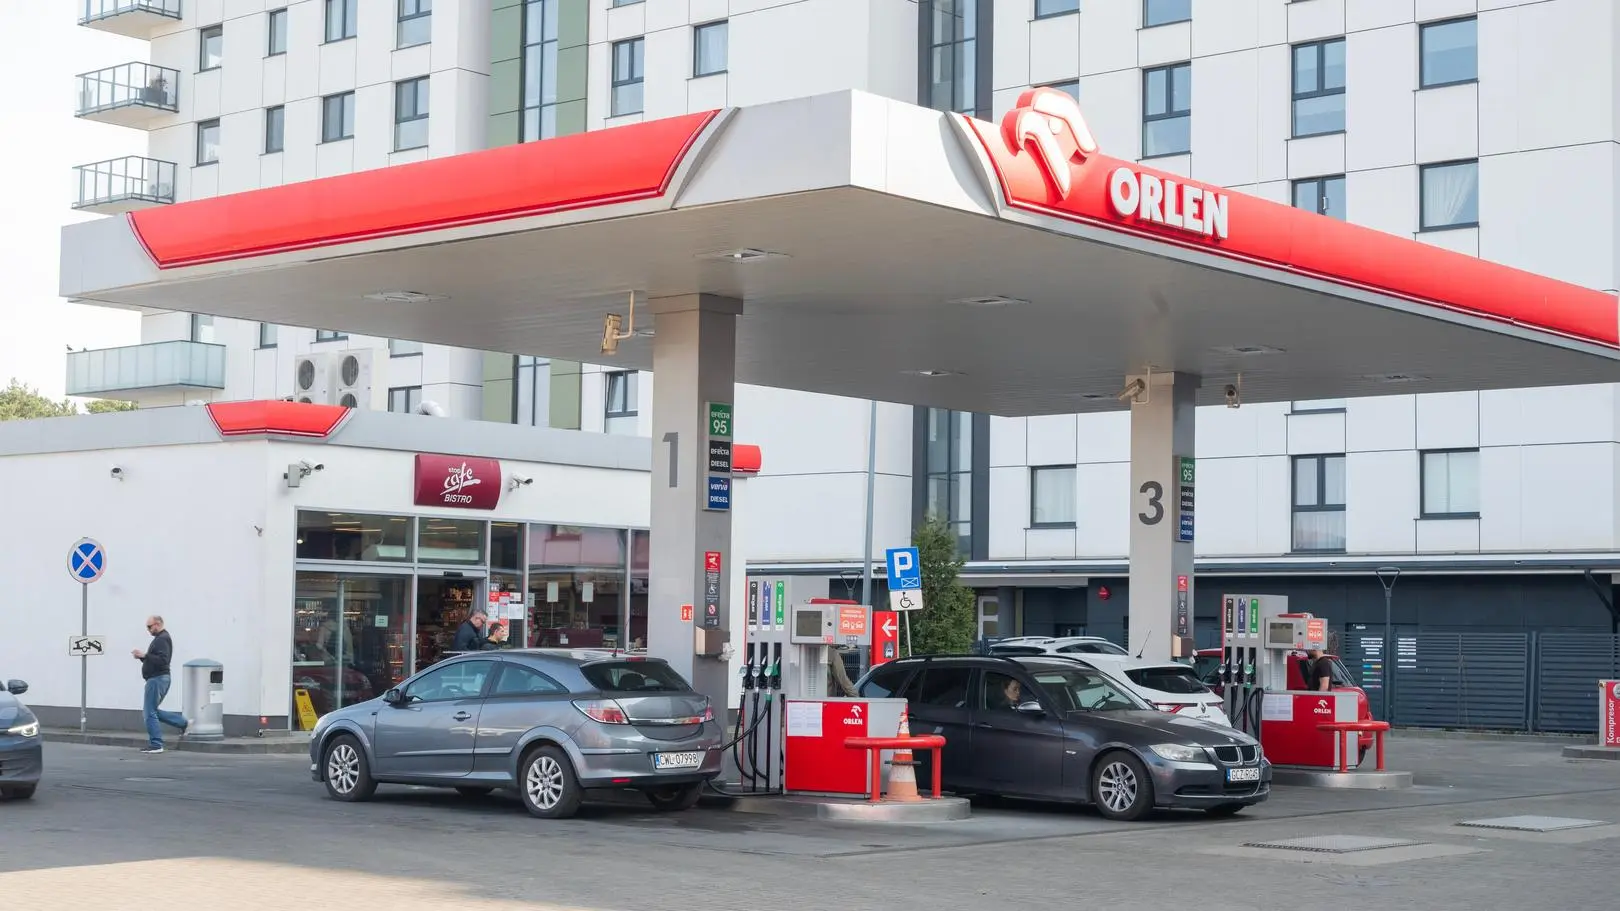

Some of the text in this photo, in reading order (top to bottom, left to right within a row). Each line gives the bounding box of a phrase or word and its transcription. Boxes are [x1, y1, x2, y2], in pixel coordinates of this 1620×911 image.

[1109, 166, 1228, 240] ORLEN
[713, 419, 727, 434] 95
[662, 431, 679, 488] 1
[710, 460, 729, 468] DIESEL
[1183, 468, 1193, 481] 95
[444, 494, 473, 504] BISTRO
[709, 495, 728, 504] DIESEL
[1138, 480, 1164, 526] 3
[893, 551, 913, 578] P
[1606, 698, 1617, 744] Kompresor
